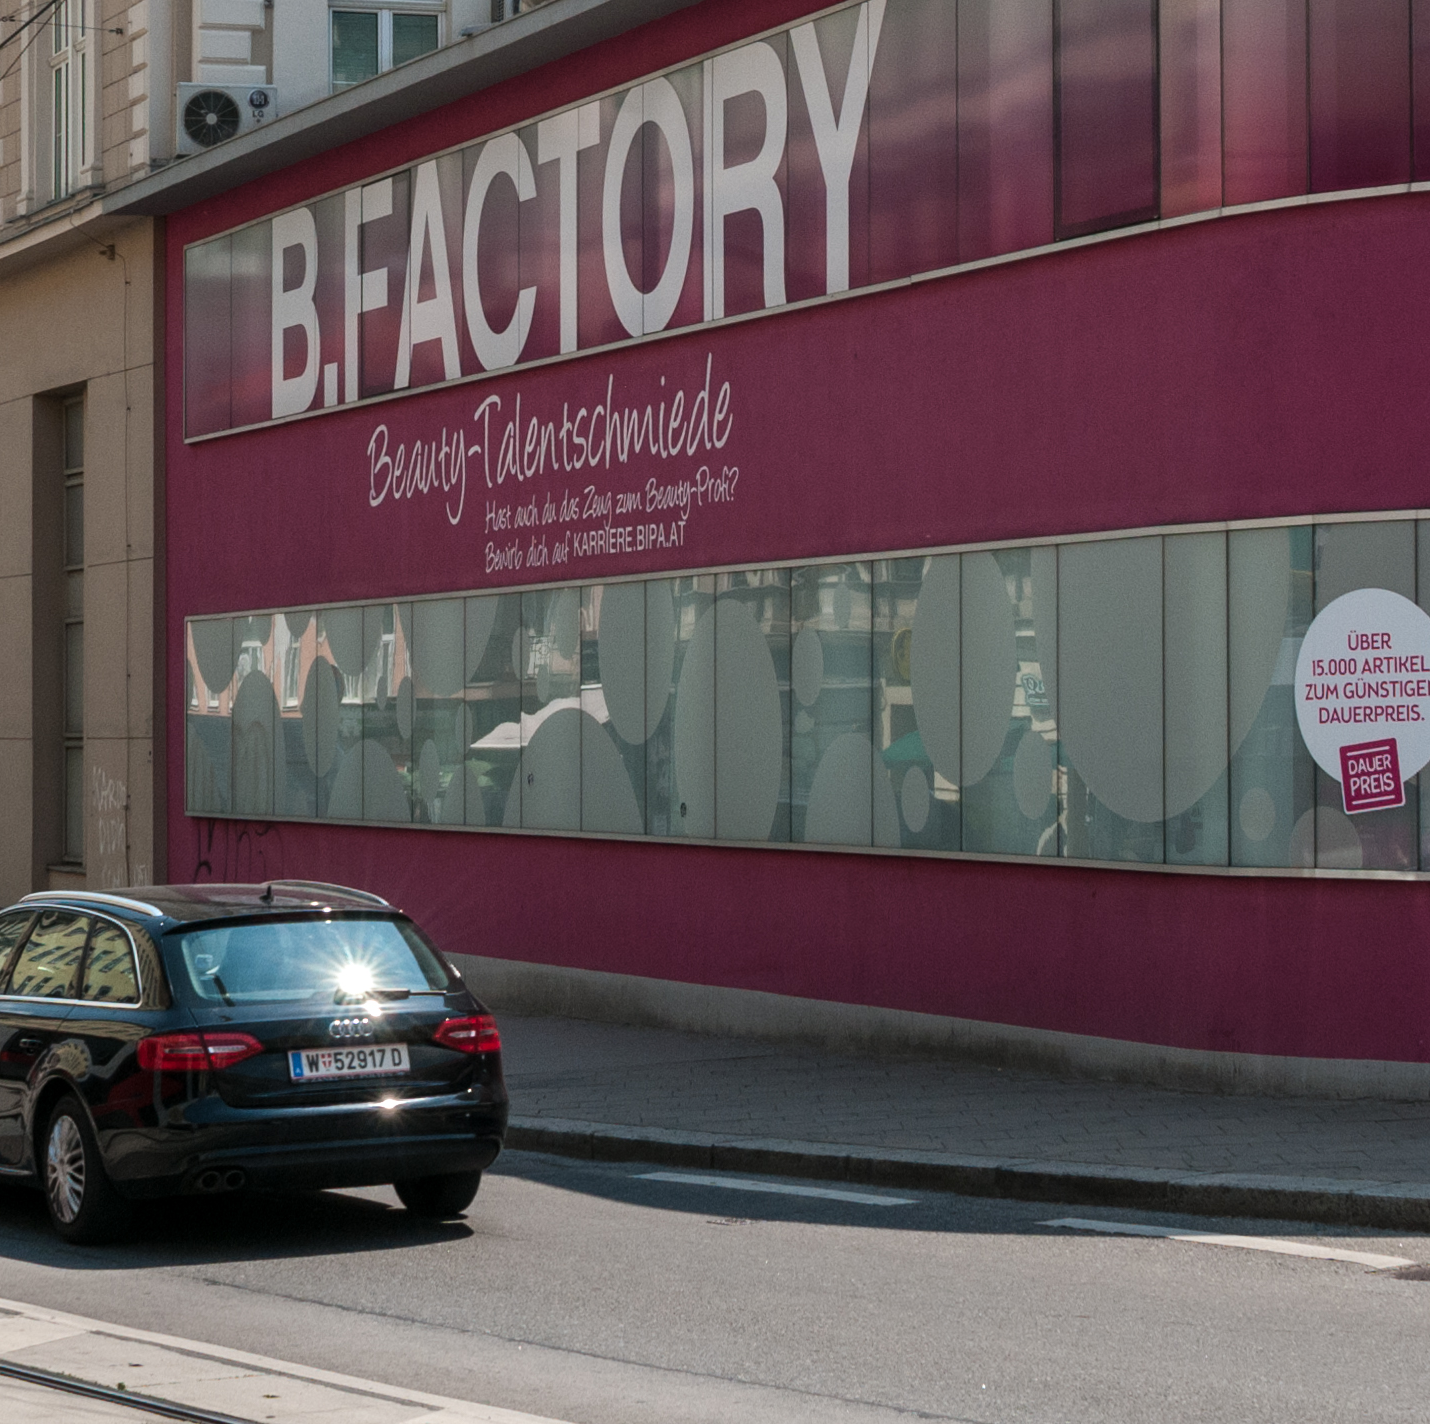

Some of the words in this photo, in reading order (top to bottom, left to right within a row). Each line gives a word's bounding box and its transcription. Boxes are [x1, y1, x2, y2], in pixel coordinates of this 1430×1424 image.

[368, 352, 734, 525] Beauty-Talentschmiede
[485, 500, 512, 534] Hast
[514, 494, 539, 528] auch
[542, 491, 557, 526] du
[559, 489, 579, 523] das
[582, 485, 612, 529] Zeug
[616, 490, 642, 515] zum
[645, 465, 739, 520] Beauty-Profi?
[526, 533, 549, 567] dich
[552, 530, 571, 565] auf
[573, 520, 687, 557] KARRIERE.BIPA.AT
[1347, 629, 1392, 651] ÜBER
[1312, 658, 1357, 677] 15.000
[1361, 655, 1430, 675] ARTIKEL
[1304, 682, 1339, 701] ZUM
[1318, 704, 1425, 724] DAUERPREIS.
[1348, 754, 1392, 776] DAUER
[1350, 772, 1395, 796] PREIS
[333, 1048, 386, 1071] 52917
